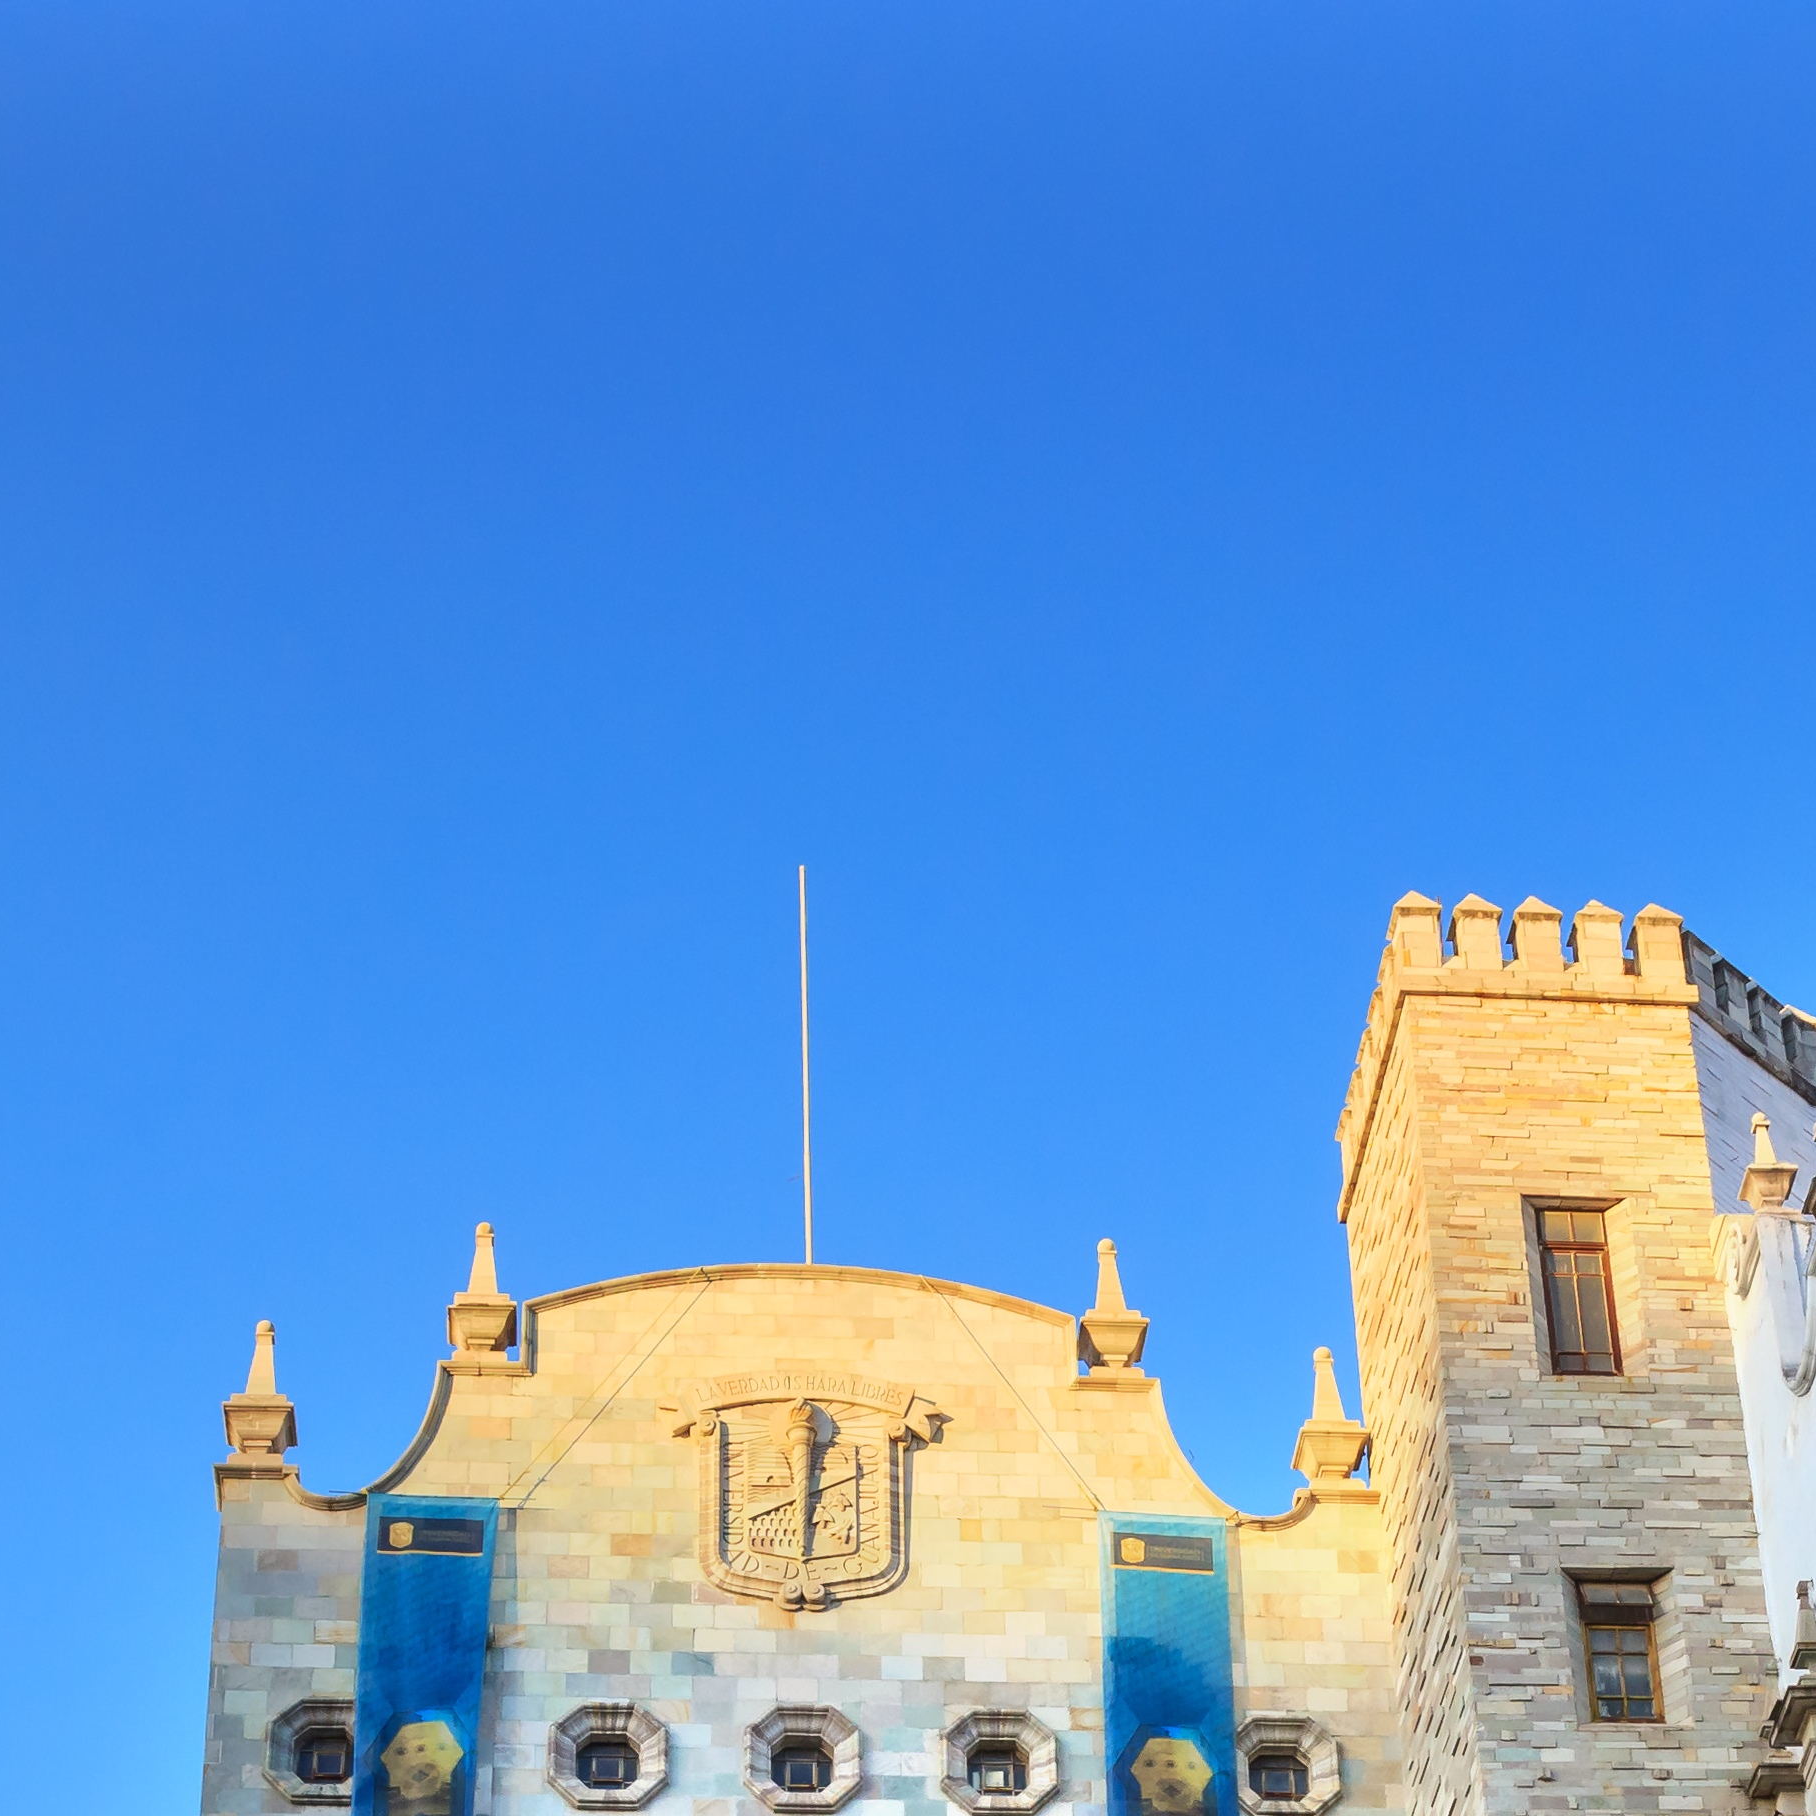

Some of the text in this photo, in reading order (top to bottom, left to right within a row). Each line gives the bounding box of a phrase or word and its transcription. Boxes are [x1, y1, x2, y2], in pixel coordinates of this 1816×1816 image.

[695, 1375, 906, 1406] LA VERDAD OS HARA LIBRES
[782, 1561, 822, 1582] DE
[843, 1443, 881, 1575] GUANAJUATO
